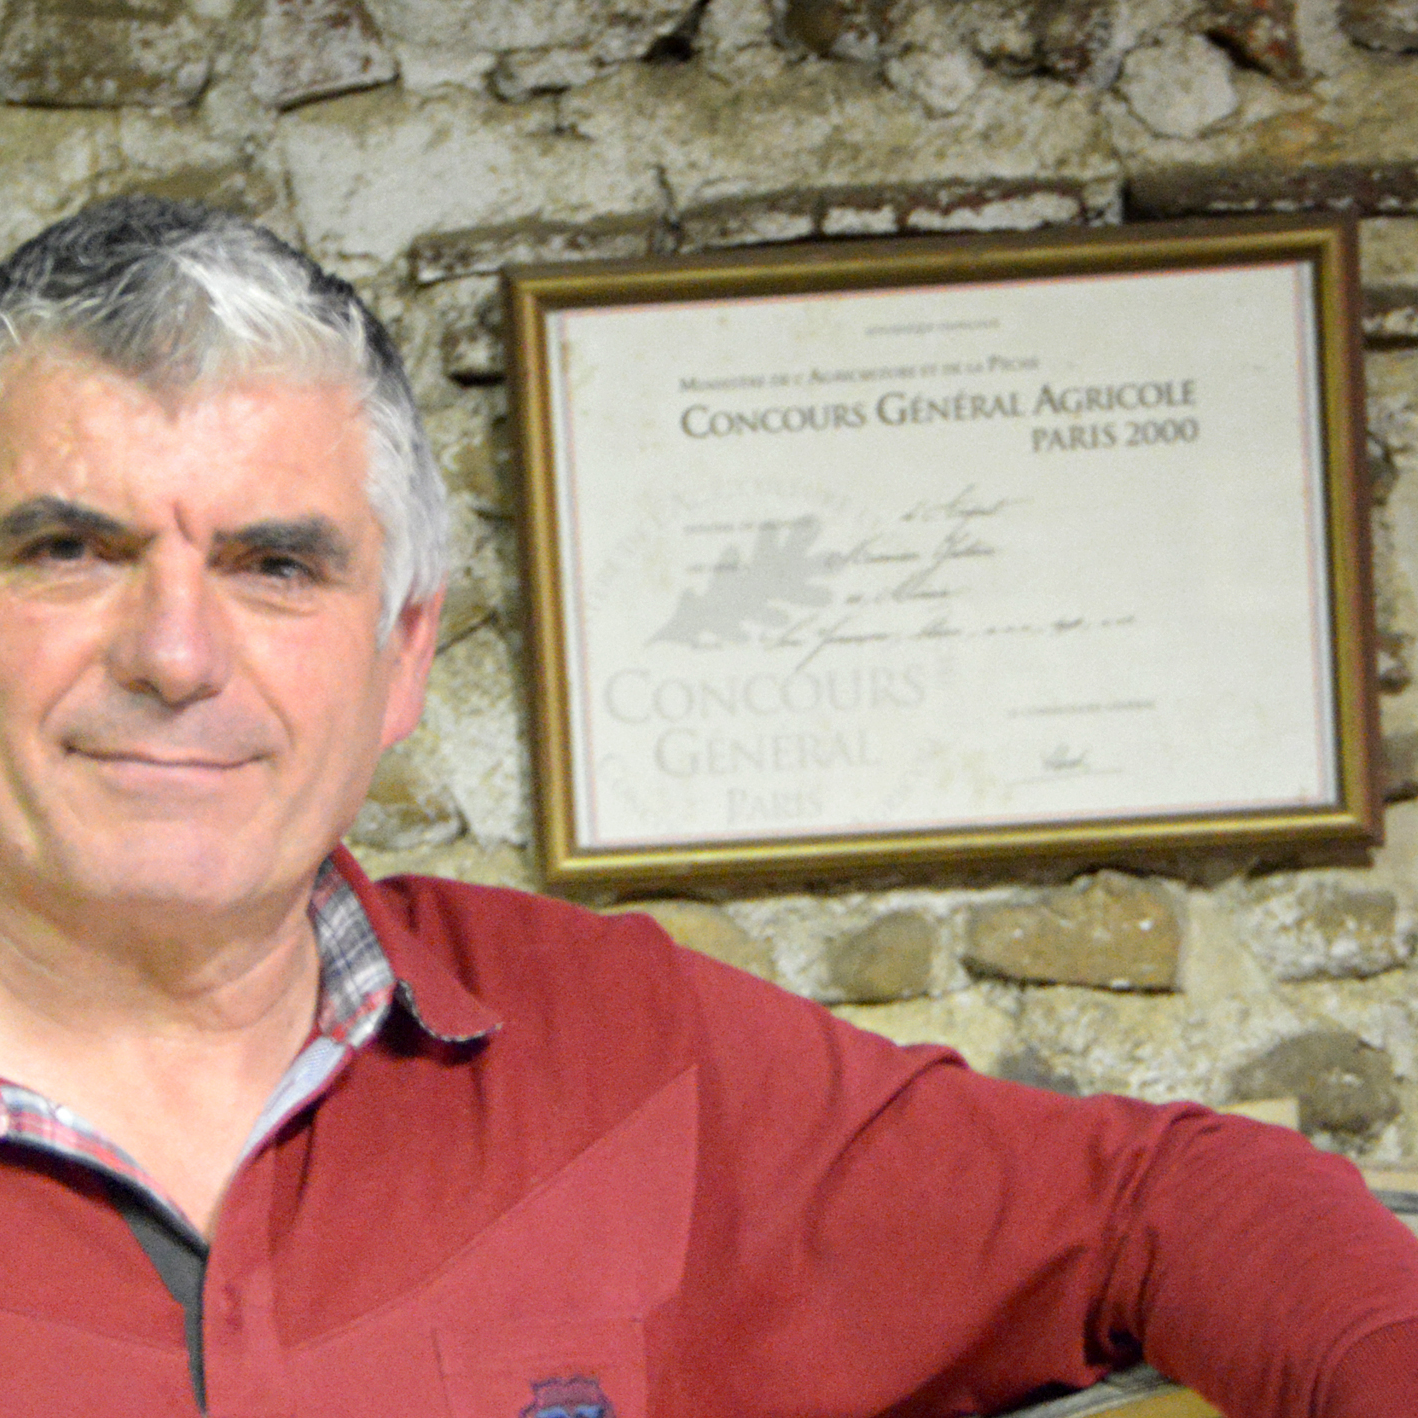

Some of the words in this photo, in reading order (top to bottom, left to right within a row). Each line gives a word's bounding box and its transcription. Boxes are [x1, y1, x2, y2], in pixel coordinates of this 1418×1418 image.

[679, 402, 867, 440] CONCOURS
[875, 389, 1026, 426] GÉNÉRAL
[1033, 376, 1199, 416] AGRICOLE
[1031, 420, 1118, 453] PARIS
[1125, 415, 1200, 447] 2000
[603, 664, 926, 726] CONCOURS
